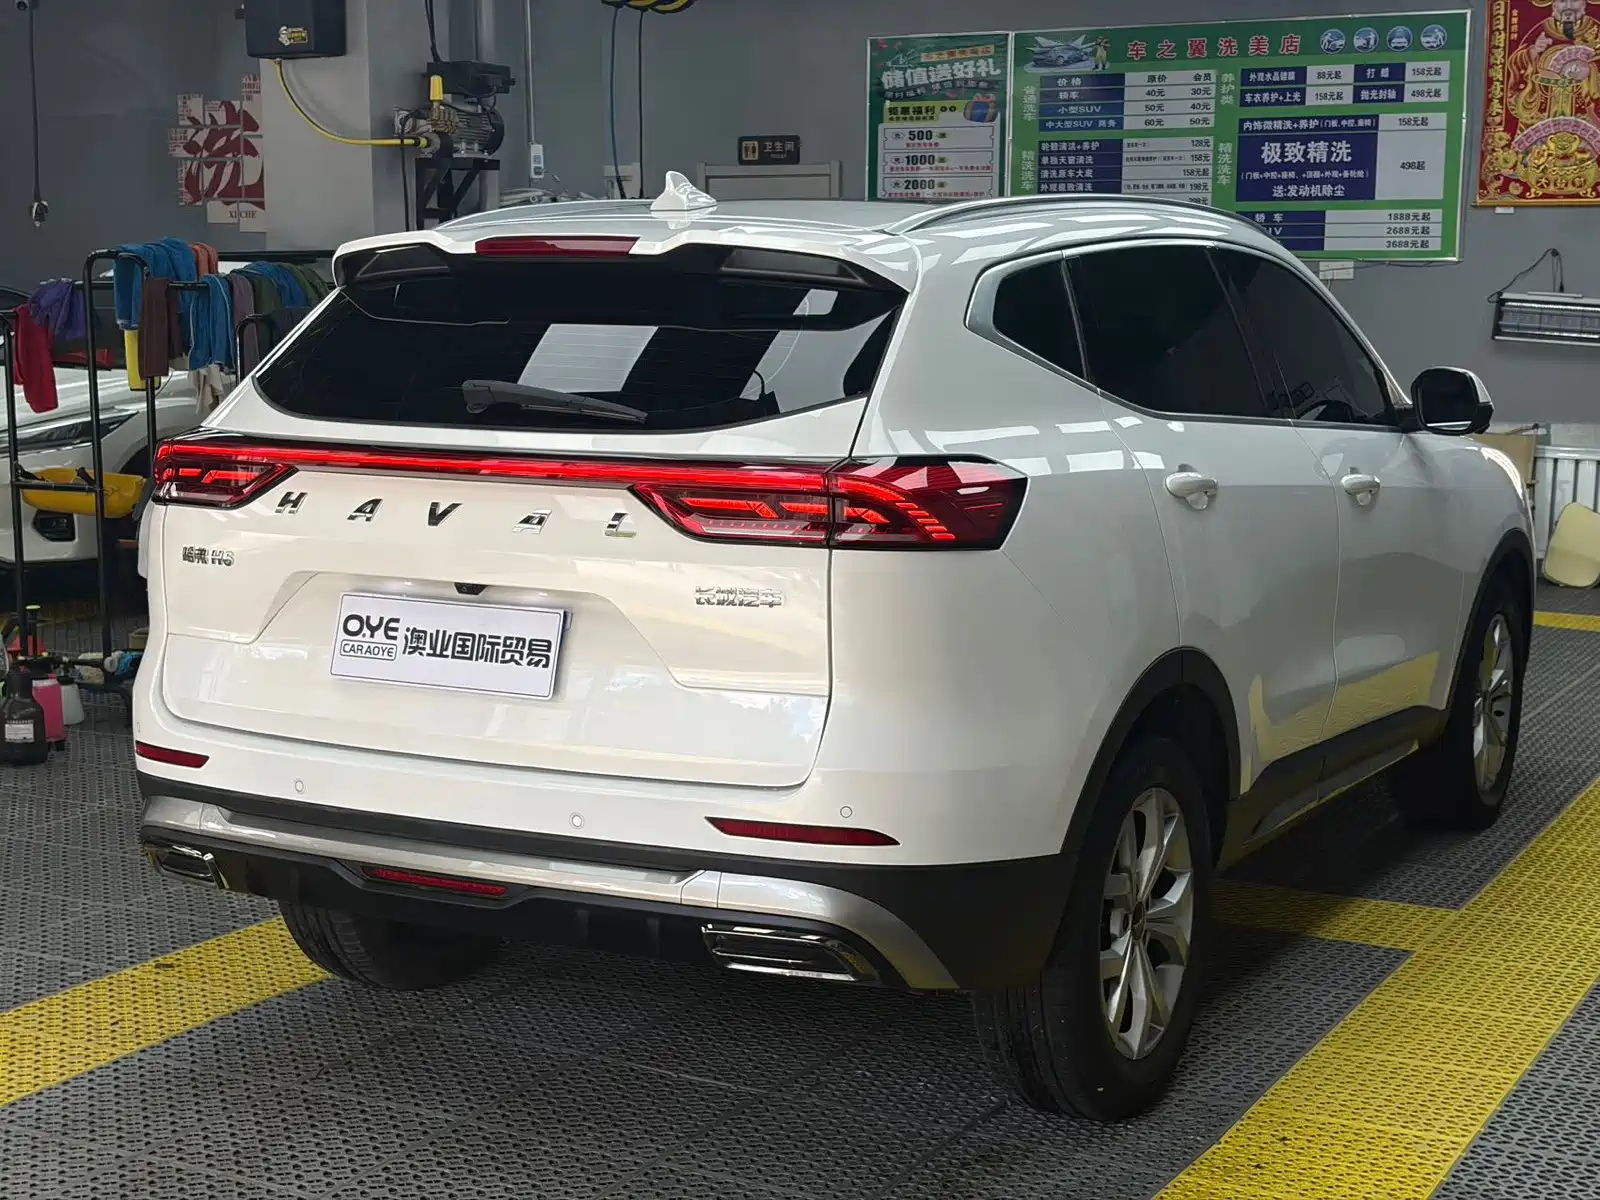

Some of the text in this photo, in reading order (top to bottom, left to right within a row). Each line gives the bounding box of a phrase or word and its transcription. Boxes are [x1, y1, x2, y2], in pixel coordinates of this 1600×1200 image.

[1127, 34, 1301, 60] 车之翼洗美店
[881, 59, 1001, 89] 储值送好礼
[1316, 70, 1342, 80] 88元起
[1411, 66, 1442, 77] 158元起
[1146, 73, 1212, 83] 原价 会员
[1144, 87, 1212, 98] 40元 30元
[1314, 91, 1344, 101] 158元起
[1410, 88, 1442, 98] 498元起
[1057, 105, 1102, 115] 小型SUV
[1144, 102, 1211, 112] 50元 40元
[1144, 117, 1210, 127] 60元 50元
[1397, 116, 1429, 127] 158元起
[908, 129, 933, 141] 500
[763, 141, 795, 152] 卫生间
[1190, 153, 1211, 163] 158元
[1260, 140, 1353, 165] 极致精洗
[904, 154, 936, 166] 1000
[1399, 160, 1426, 171] 498起
[1182, 167, 1210, 177] 158元起
[903, 178, 936, 190] 2000
[1272, 184, 1346, 198] 送:发动机除尘
[1387, 211, 1432, 222] 1888元起
[1386, 225, 1431, 235] 2688元起
[1385, 239, 1430, 249] 3688元起
[274, 491, 637, 539] HAVAL
[211, 549, 235, 567] H6
[402, 626, 553, 669] 澳业国际贸易
